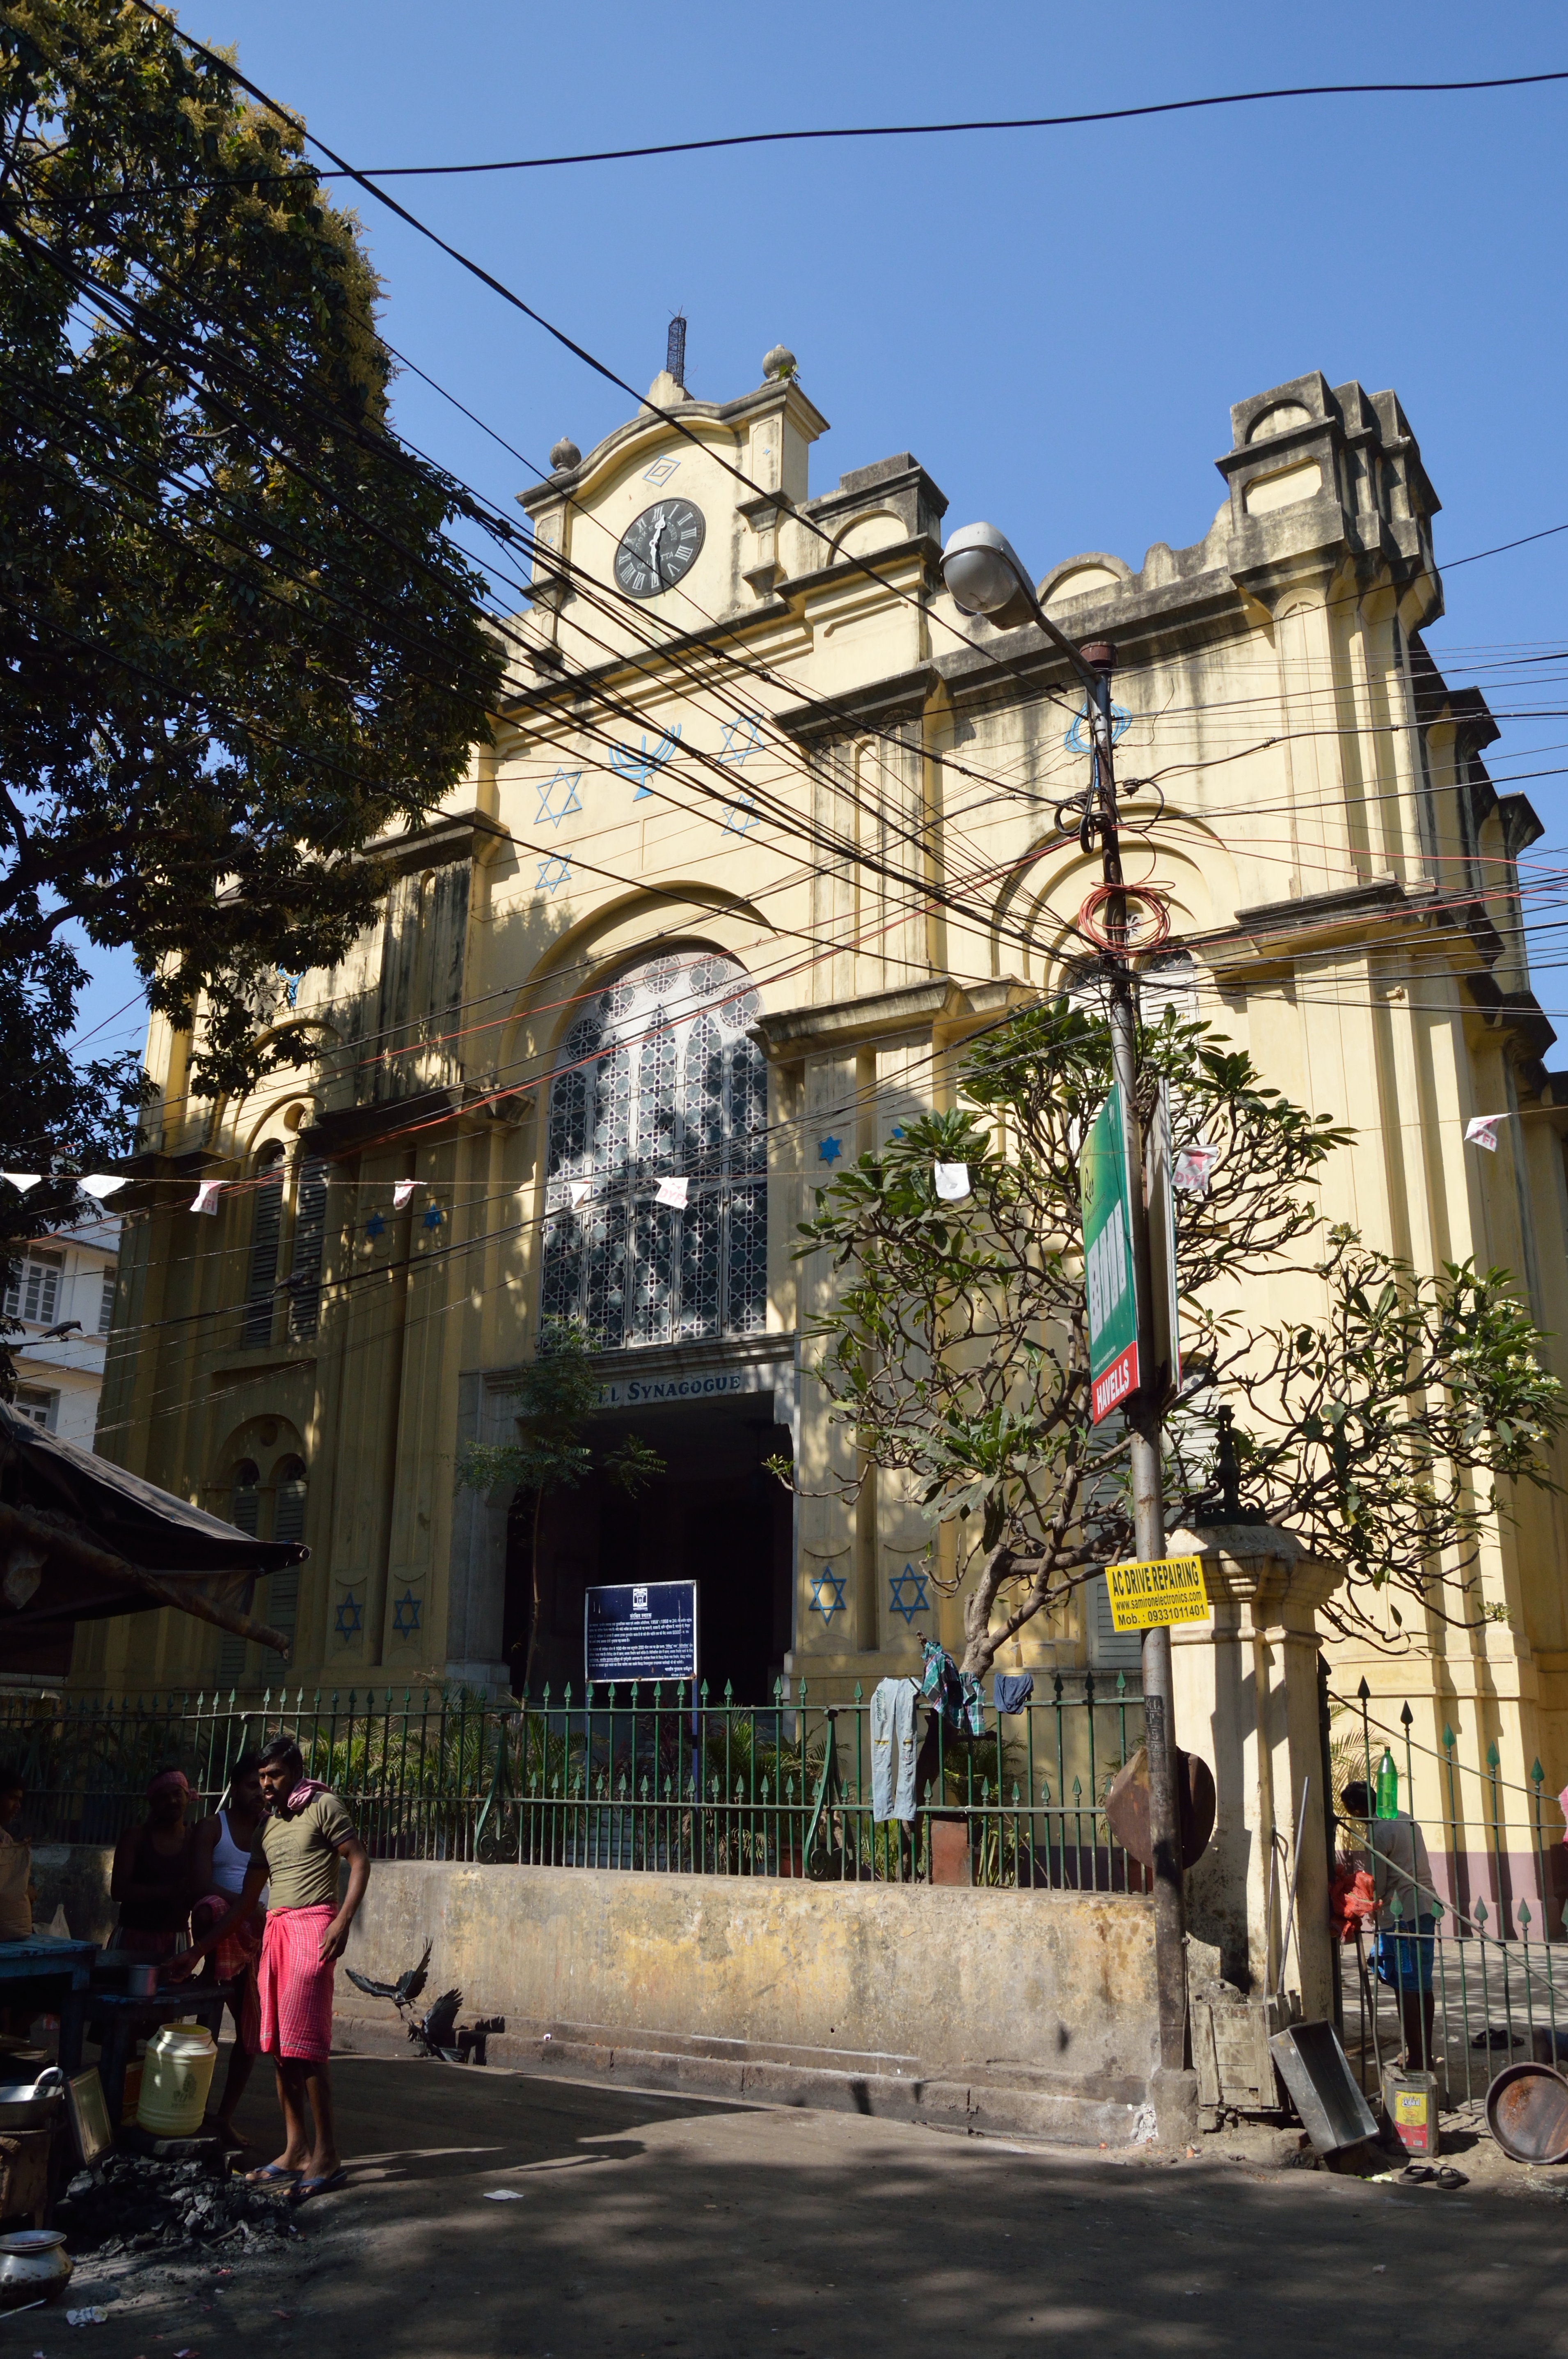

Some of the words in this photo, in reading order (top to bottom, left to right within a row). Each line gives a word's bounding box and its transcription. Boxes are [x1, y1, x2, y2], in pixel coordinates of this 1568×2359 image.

[667, 504, 680, 519] I
[677, 511, 694, 526] II
[636, 517, 647, 533] XI
[634, 525, 653, 553] COOKE
[680, 527, 697, 541] III
[674, 545, 694, 562] IIII
[667, 563, 681, 577] V
[1174, 1171, 1205, 1187] DYFI
[1096, 1358, 1129, 1415] HAVELLS
[1112, 1570, 1124, 1596] AC
[1124, 1567, 1152, 1595] DRIVE
[1151, 1561, 1199, 1591] REPAIRING
[1115, 1591, 1202, 1611] www.samironelectronics.com
[1118, 1613, 1140, 1626] Mob.
[1148, 1604, 1205, 1622] 09331011401
